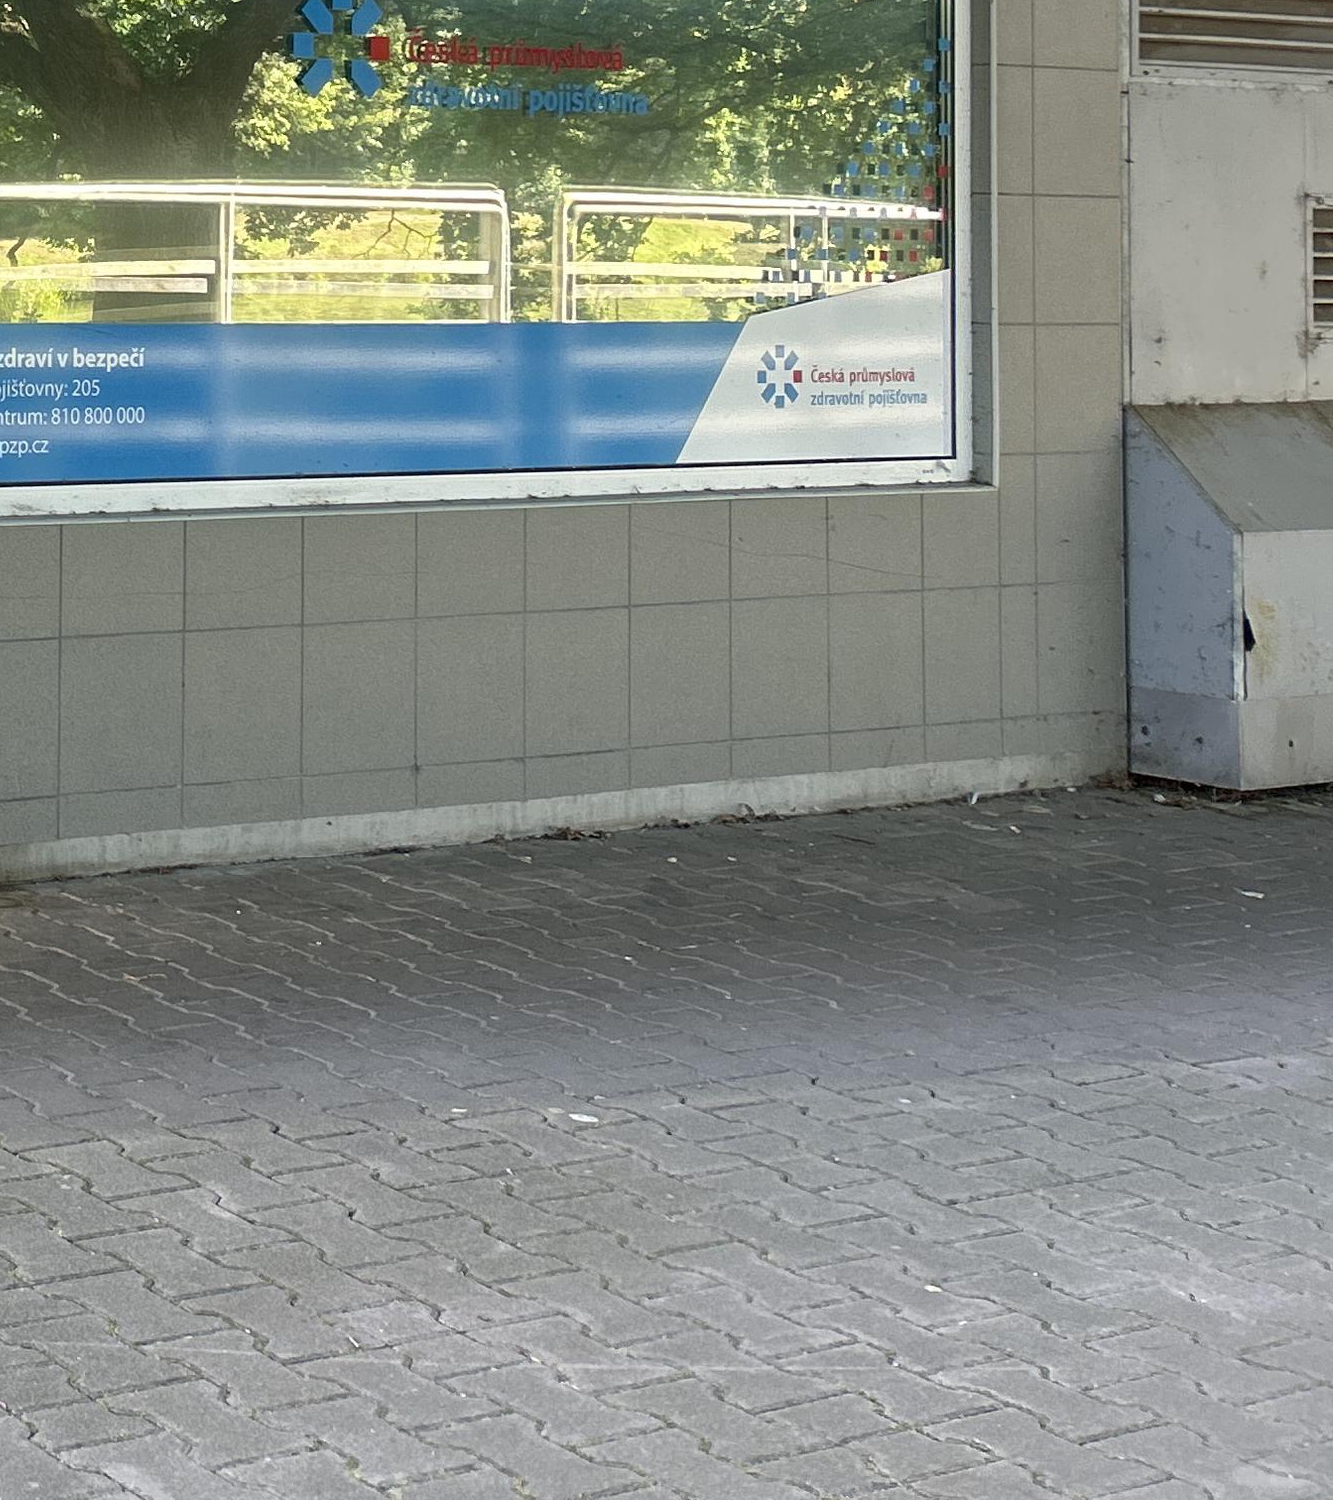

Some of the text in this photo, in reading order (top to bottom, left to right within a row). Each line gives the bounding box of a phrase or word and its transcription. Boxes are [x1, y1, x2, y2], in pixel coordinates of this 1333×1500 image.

[407, 27, 625, 75] Česká průmyslová
[526, 83, 650, 117] pojišťovna
[56, 353, 68, 368] v
[72, 347, 146, 372] bezpečí
[811, 364, 916, 386] Česká průmyslová
[72, 379, 101, 396] 205
[810, 389, 928, 408] zdravotní pojišťovna
[51, 407, 81, 425] 810
[84, 407, 113, 424] 800
[116, 406, 145, 424] 000
